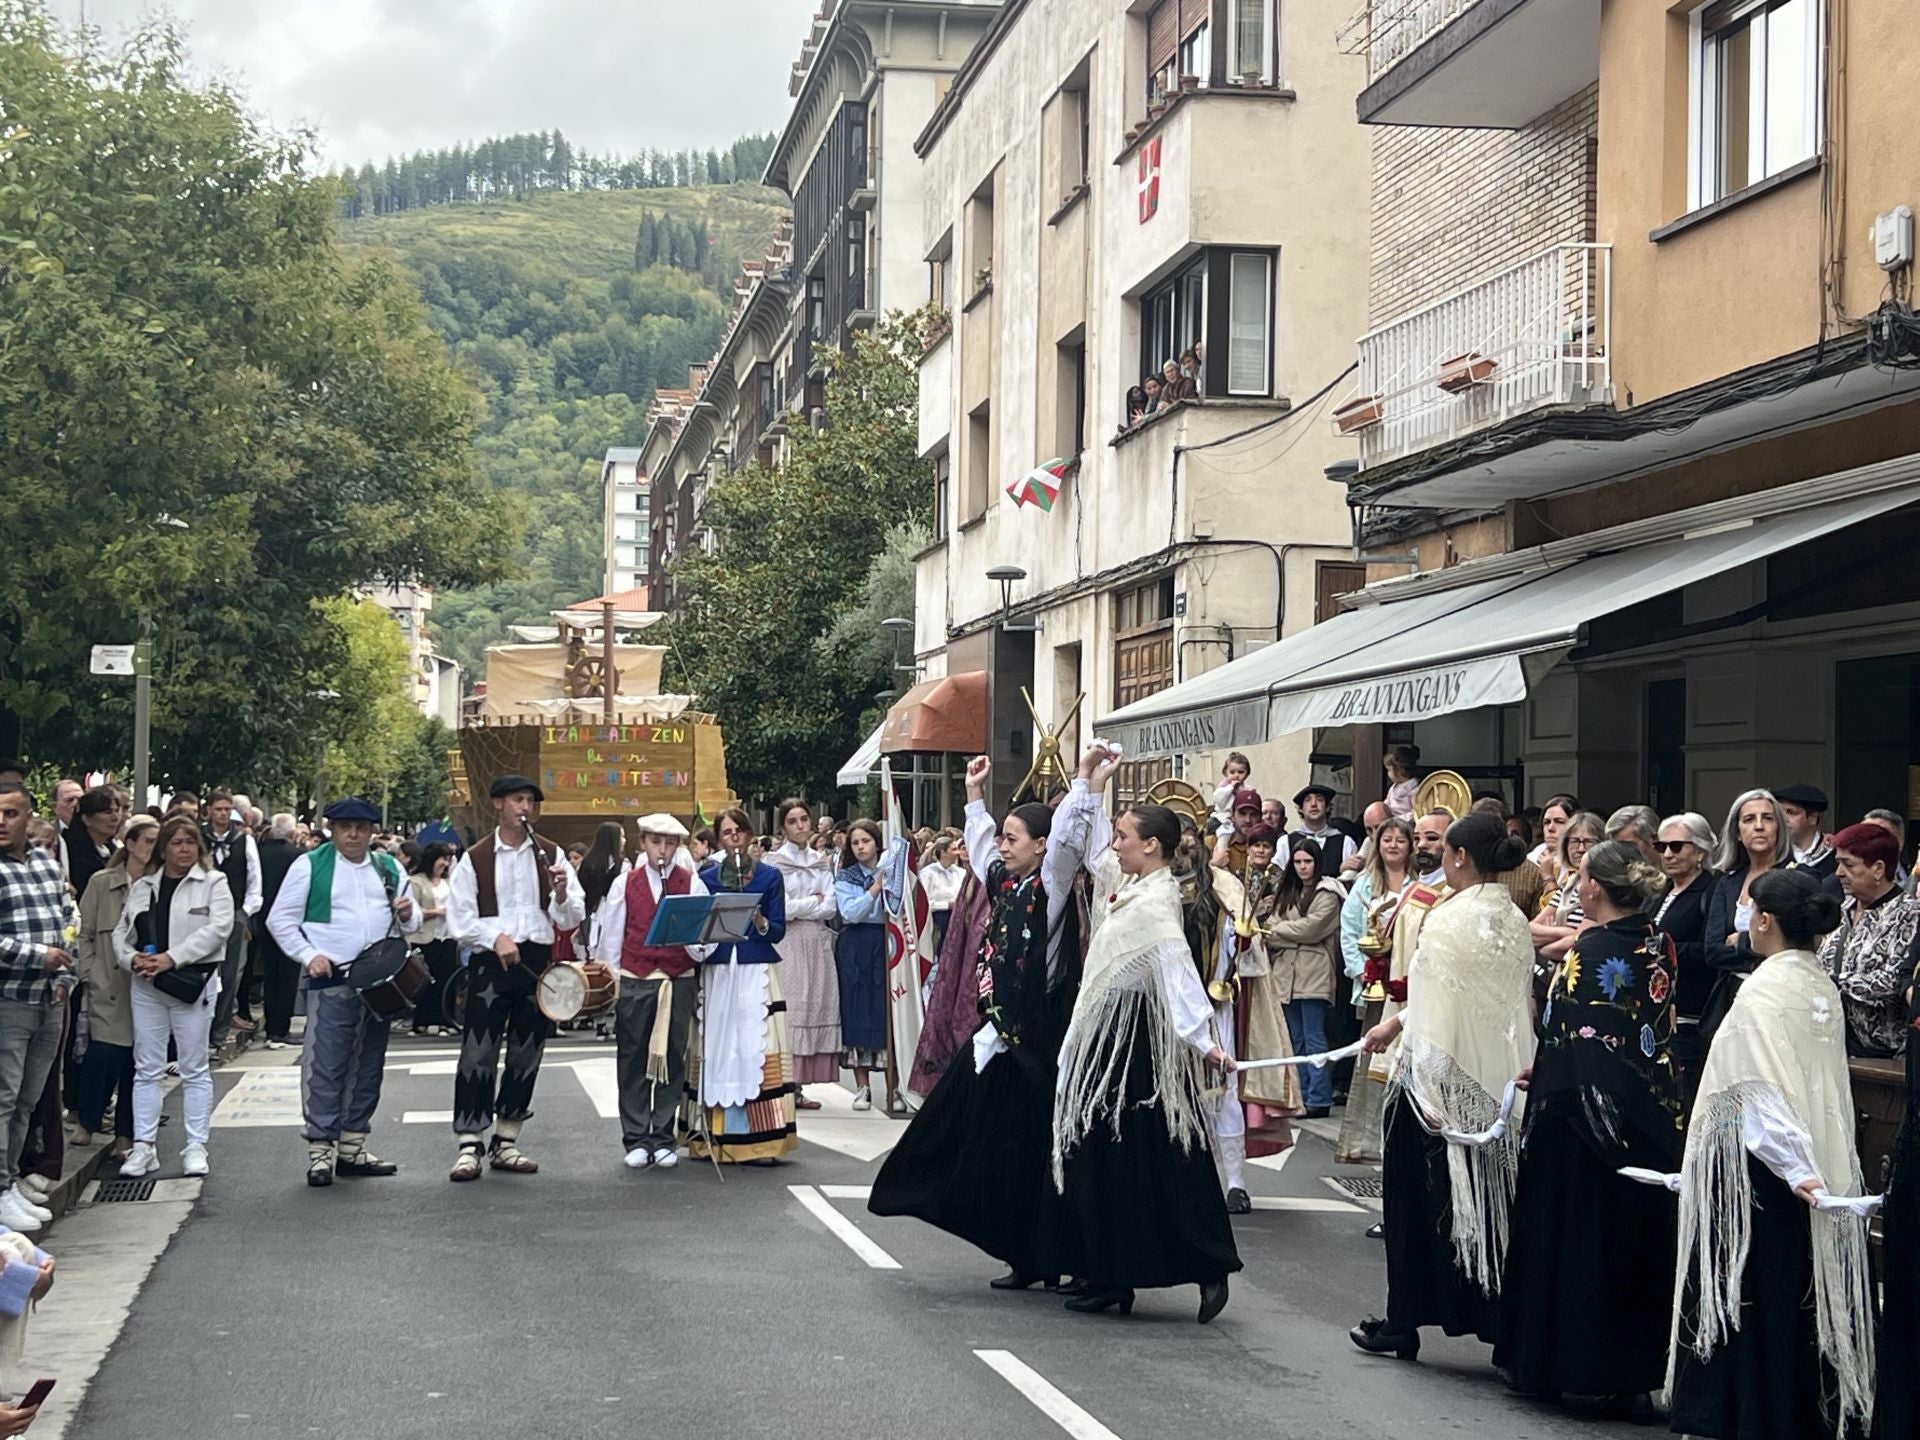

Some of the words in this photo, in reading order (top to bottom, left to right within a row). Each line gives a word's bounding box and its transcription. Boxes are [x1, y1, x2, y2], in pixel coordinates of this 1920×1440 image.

[1329, 670, 1468, 719] BRANNINGANS
[545, 726, 590, 744] IZAN
[1138, 715, 1216, 754] BRANNINGANS
[545, 769, 588, 788] IZAN
